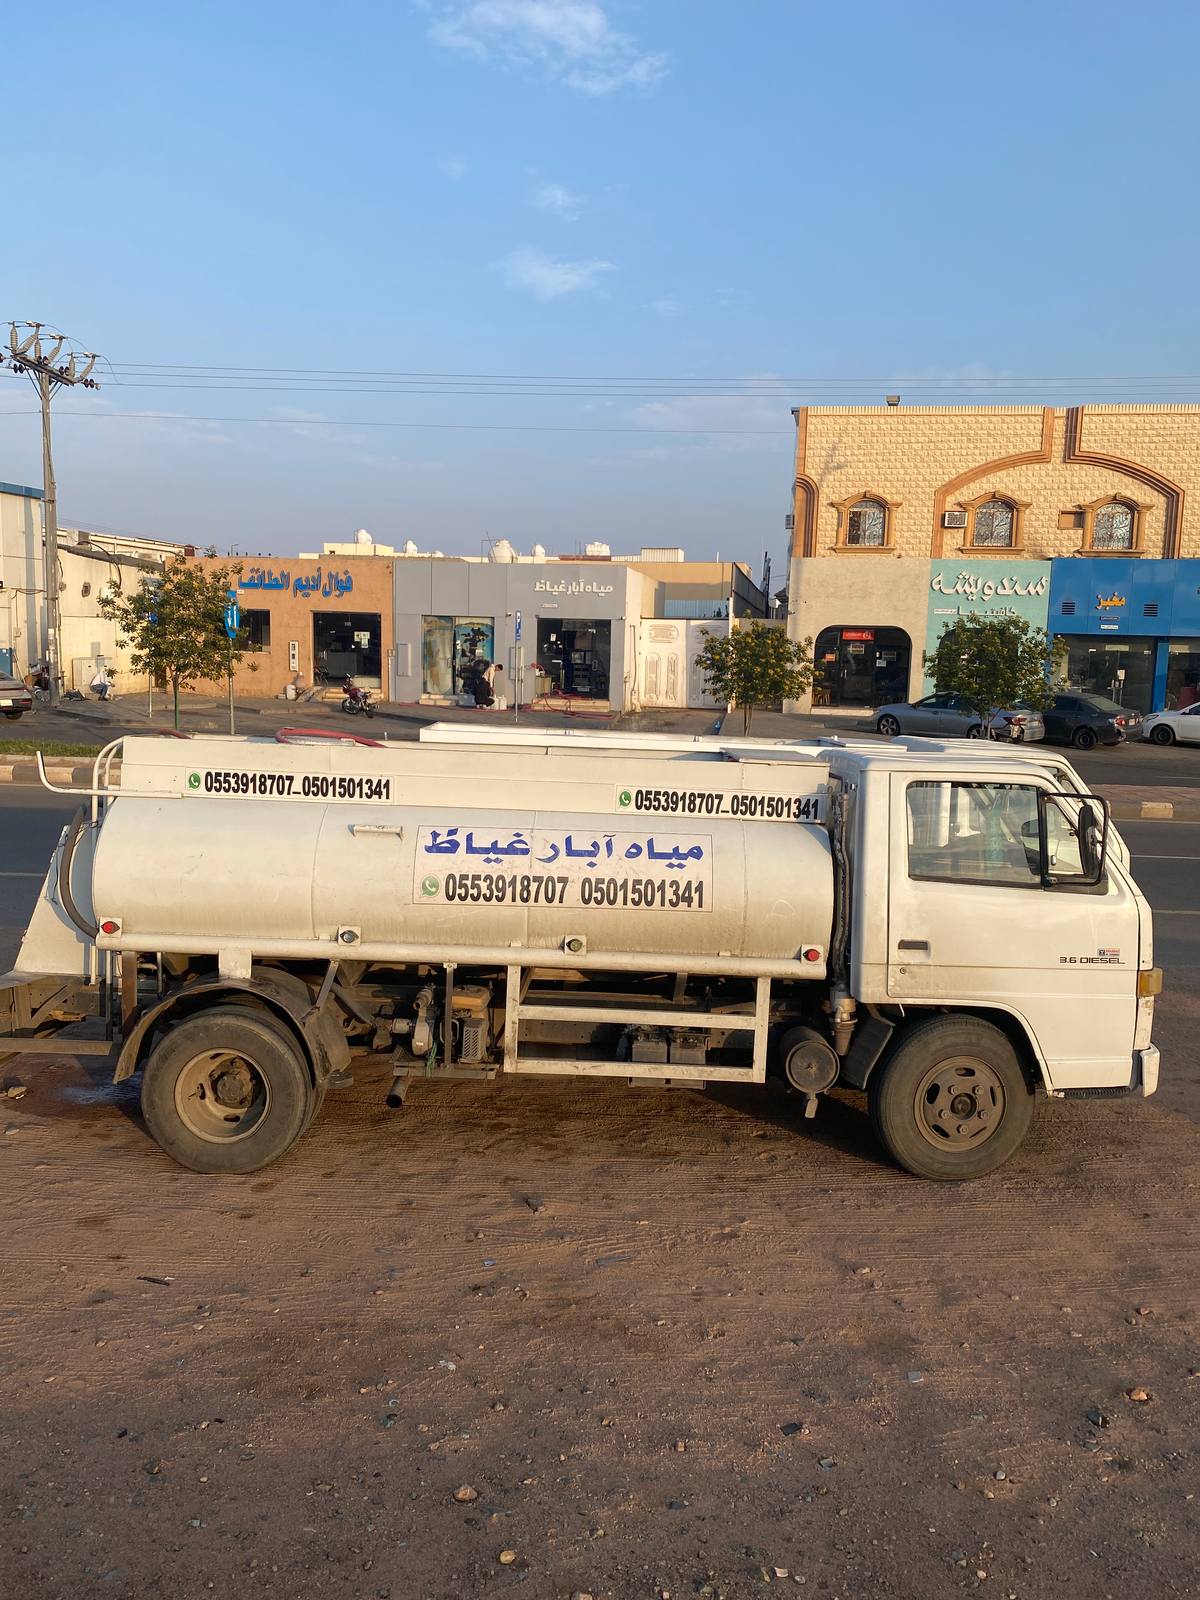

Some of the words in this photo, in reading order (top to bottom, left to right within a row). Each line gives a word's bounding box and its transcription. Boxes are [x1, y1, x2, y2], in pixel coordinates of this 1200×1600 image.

[238, 568, 290, 591] الطائف
[321, 570, 353, 598] فوال
[566, 579, 584, 595] آبار
[584, 581, 613, 597] مياه
[535, 833, 616, 869] آبار
[624, 837, 704, 870] مياه
[444, 872, 569, 904] 0553918707
[580, 877, 704, 909] 0501501341
[1059, 956, 1077, 964] 3.6
[1079, 957, 1126, 965] DIESEL
